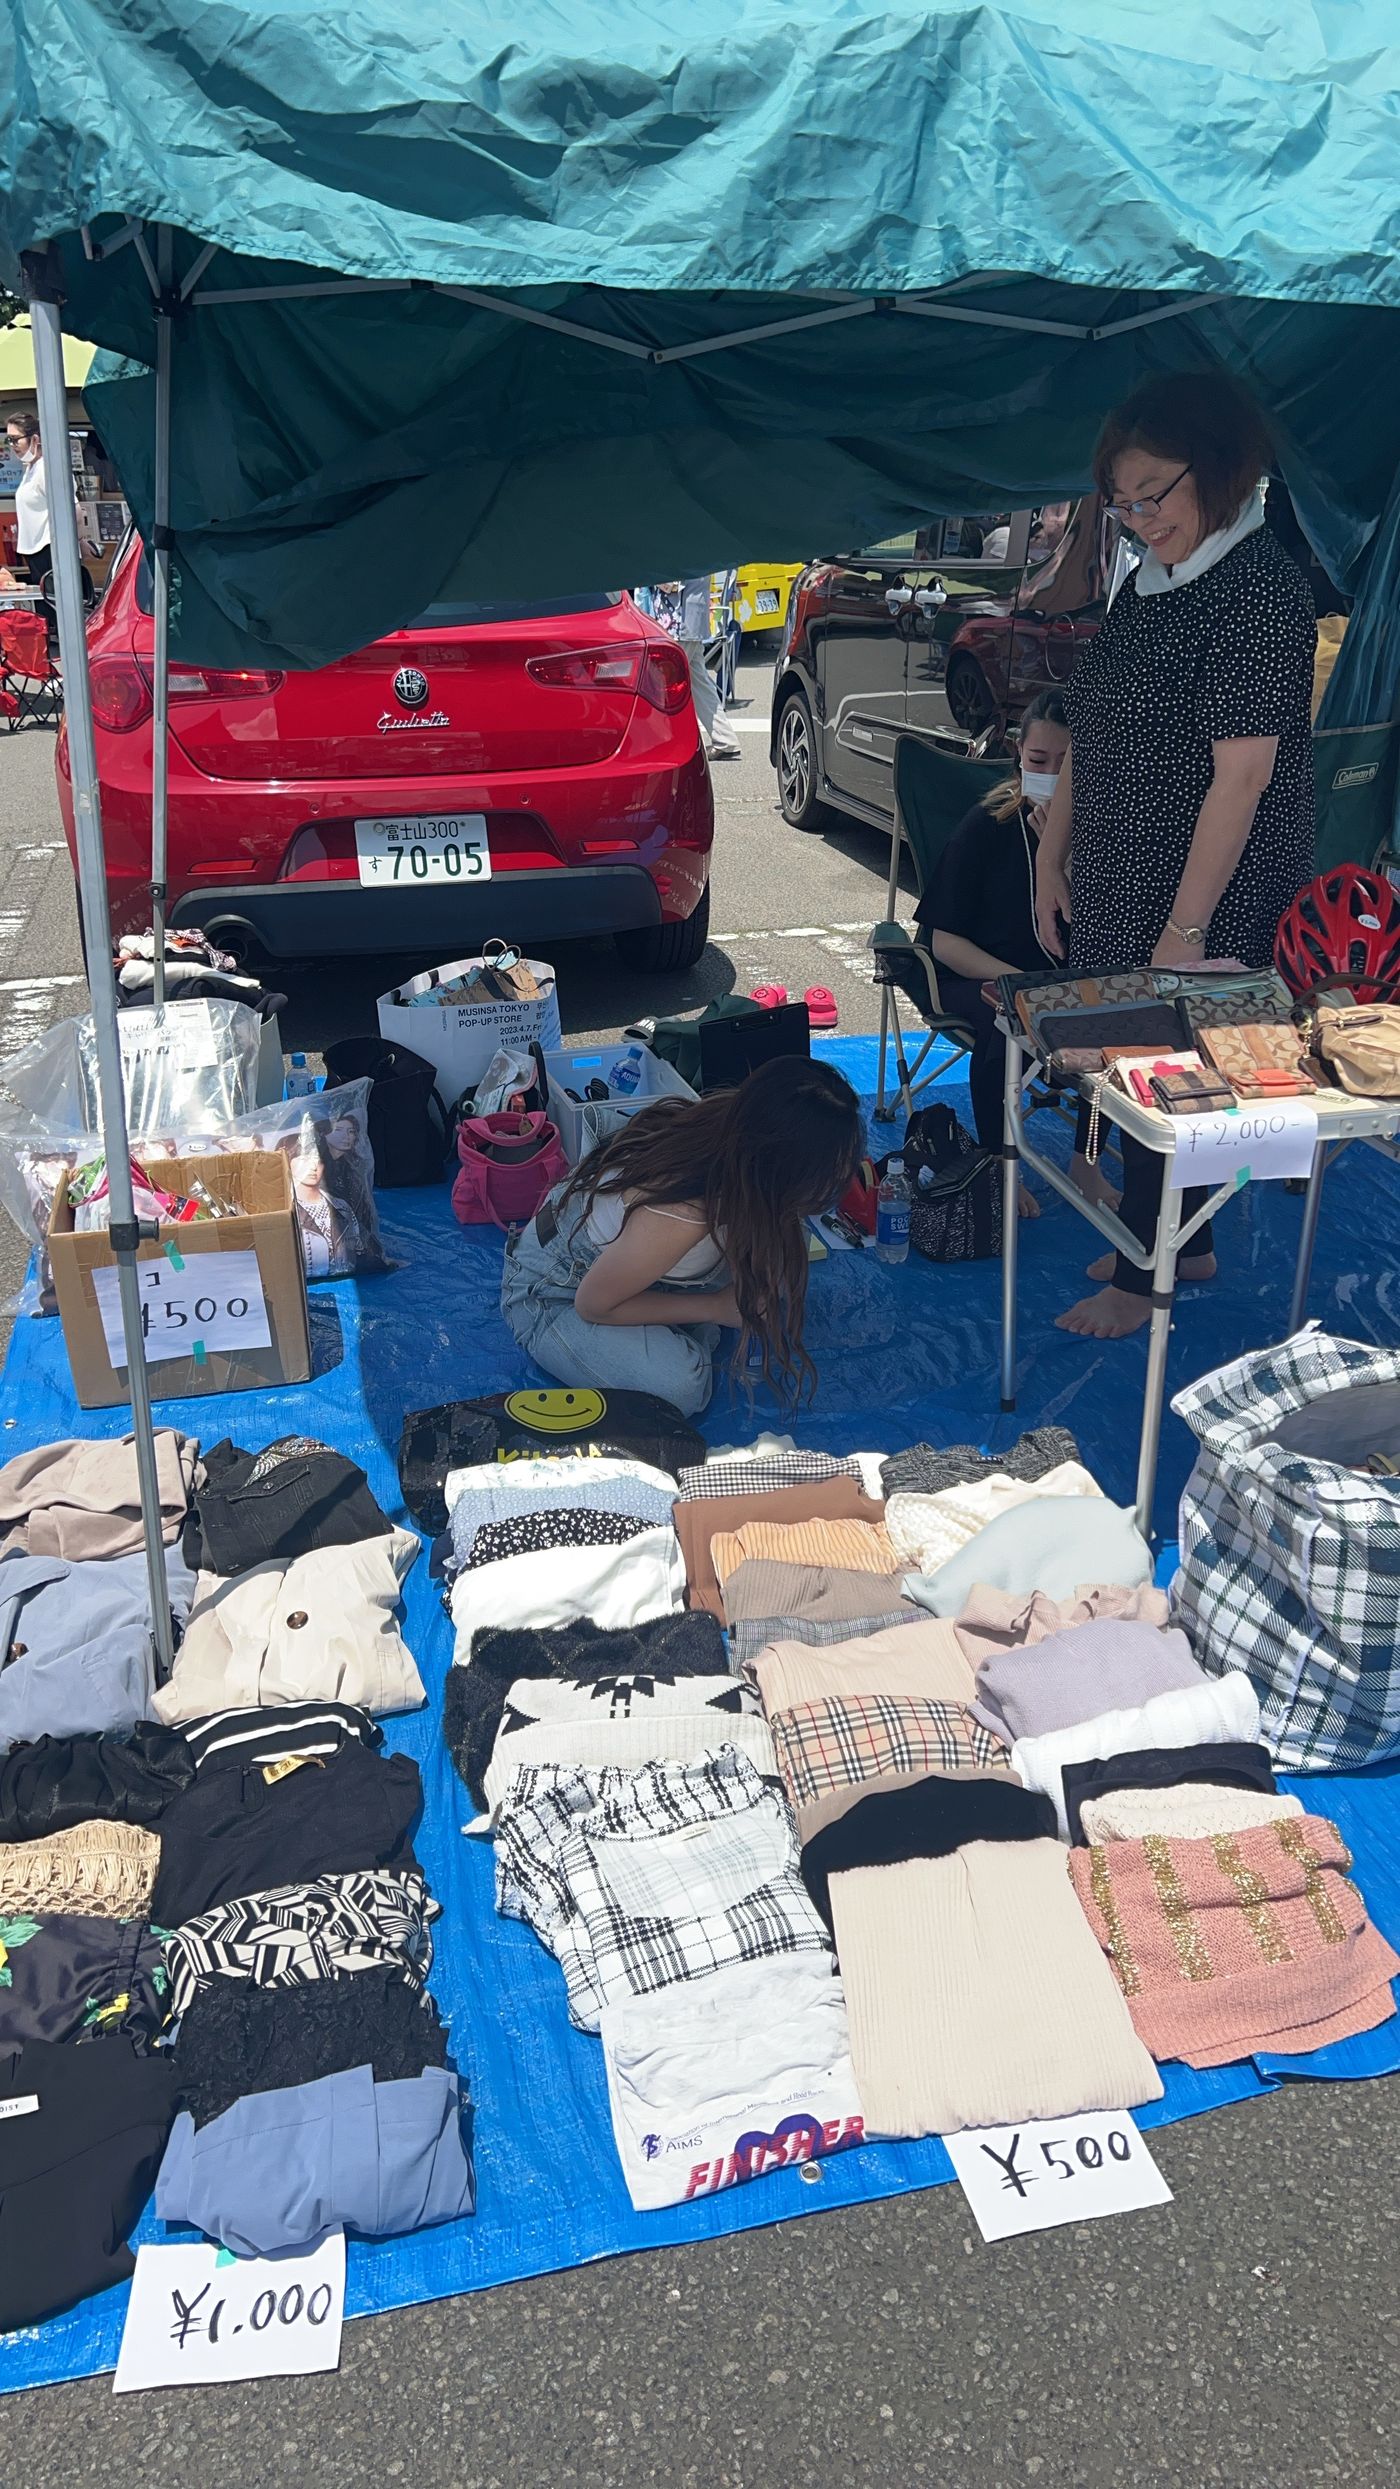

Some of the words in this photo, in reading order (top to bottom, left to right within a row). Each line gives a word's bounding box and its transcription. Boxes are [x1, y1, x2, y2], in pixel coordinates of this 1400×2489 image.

[377, 711, 450, 734] Giulietta
[385, 820, 459, 842] 富士山300
[368, 856, 383, 873] す
[387, 841, 483, 880] 70-05
[457, 1005, 497, 1018] MUSINSA
[499, 1003, 530, 1013] TOKYO
[459, 1017, 492, 1029] POP-UP
[493, 1014, 522, 1025] STORE
[500, 1038, 520, 1046] 11:00
[519, 1034, 533, 1043] AM
[665, 2134, 703, 2153] AIMS
[683, 2115, 864, 2200] FINISHER
[979, 2130, 1132, 2198] ¥500
